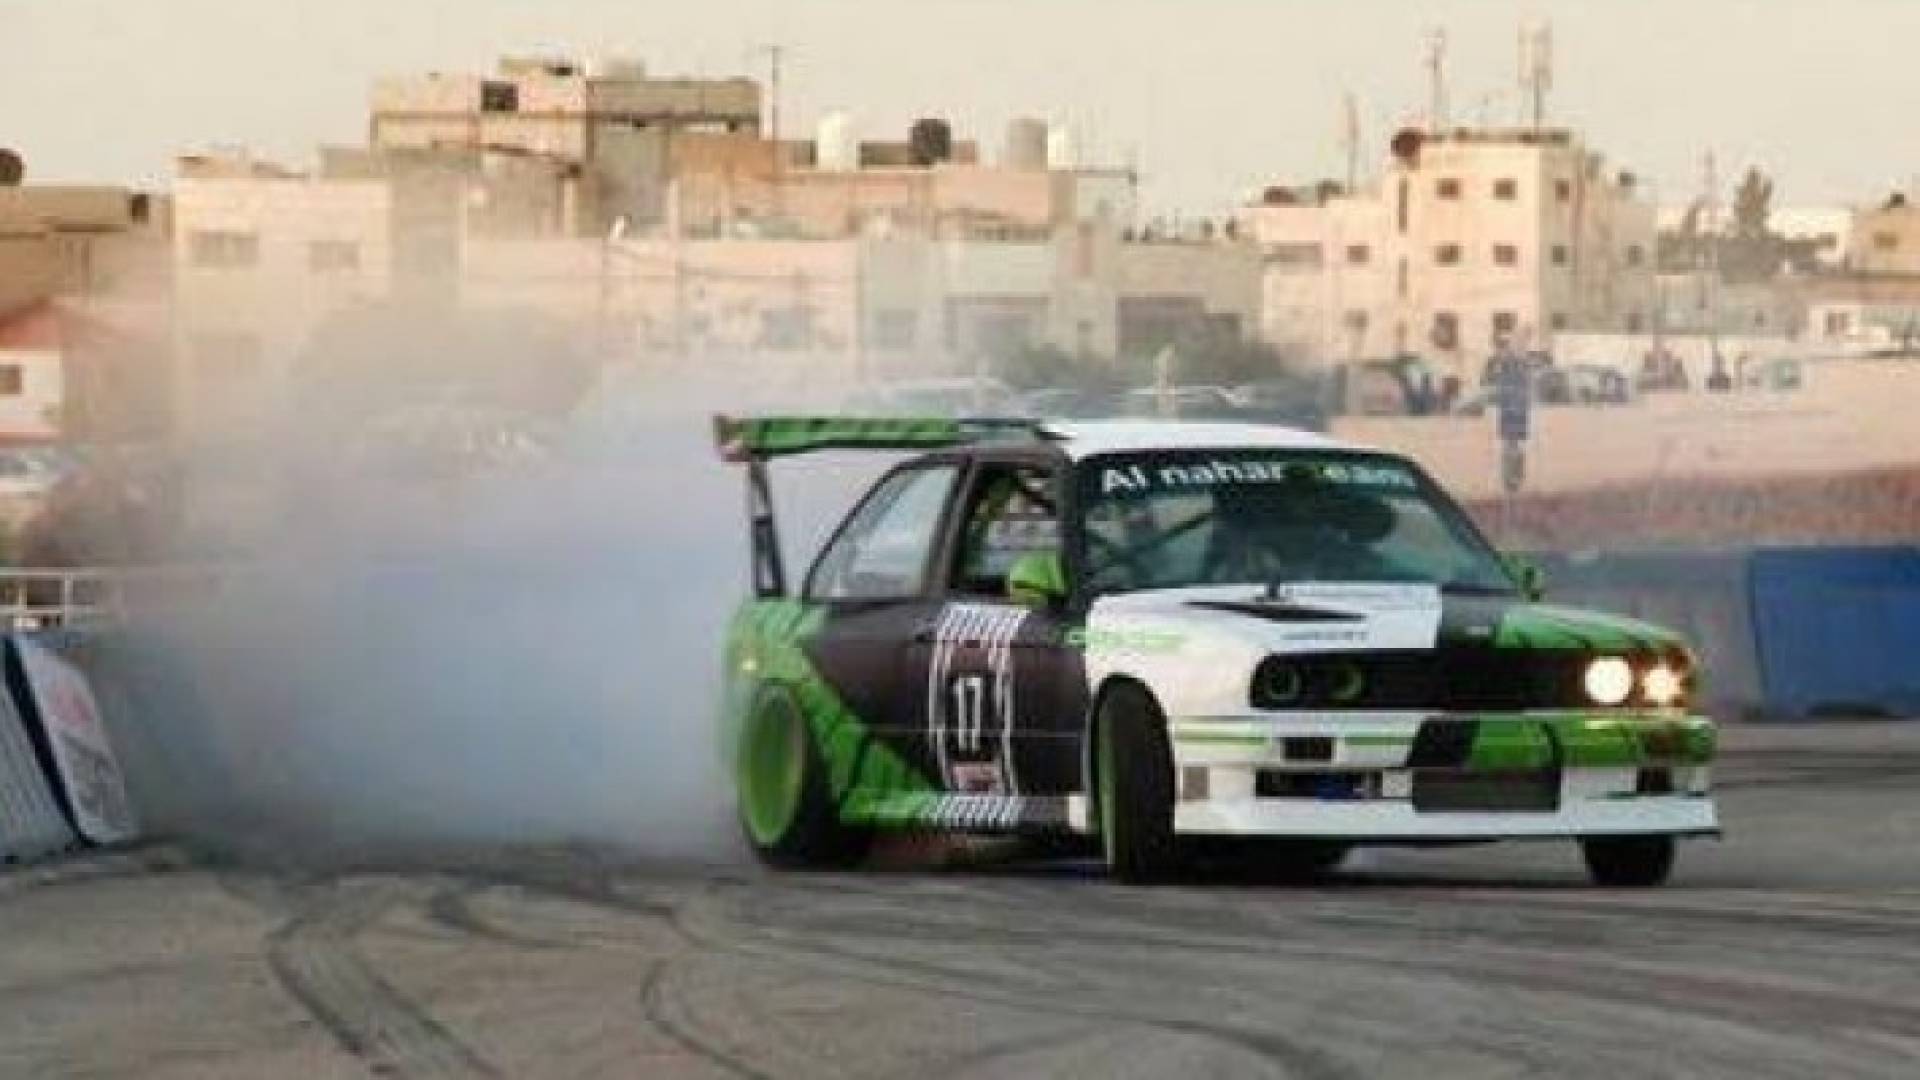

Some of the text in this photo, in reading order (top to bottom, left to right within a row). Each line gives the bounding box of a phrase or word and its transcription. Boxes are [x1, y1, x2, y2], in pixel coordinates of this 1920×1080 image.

[1101, 461, 1416, 493] Al nahar eam
[953, 676, 982, 752] 17
